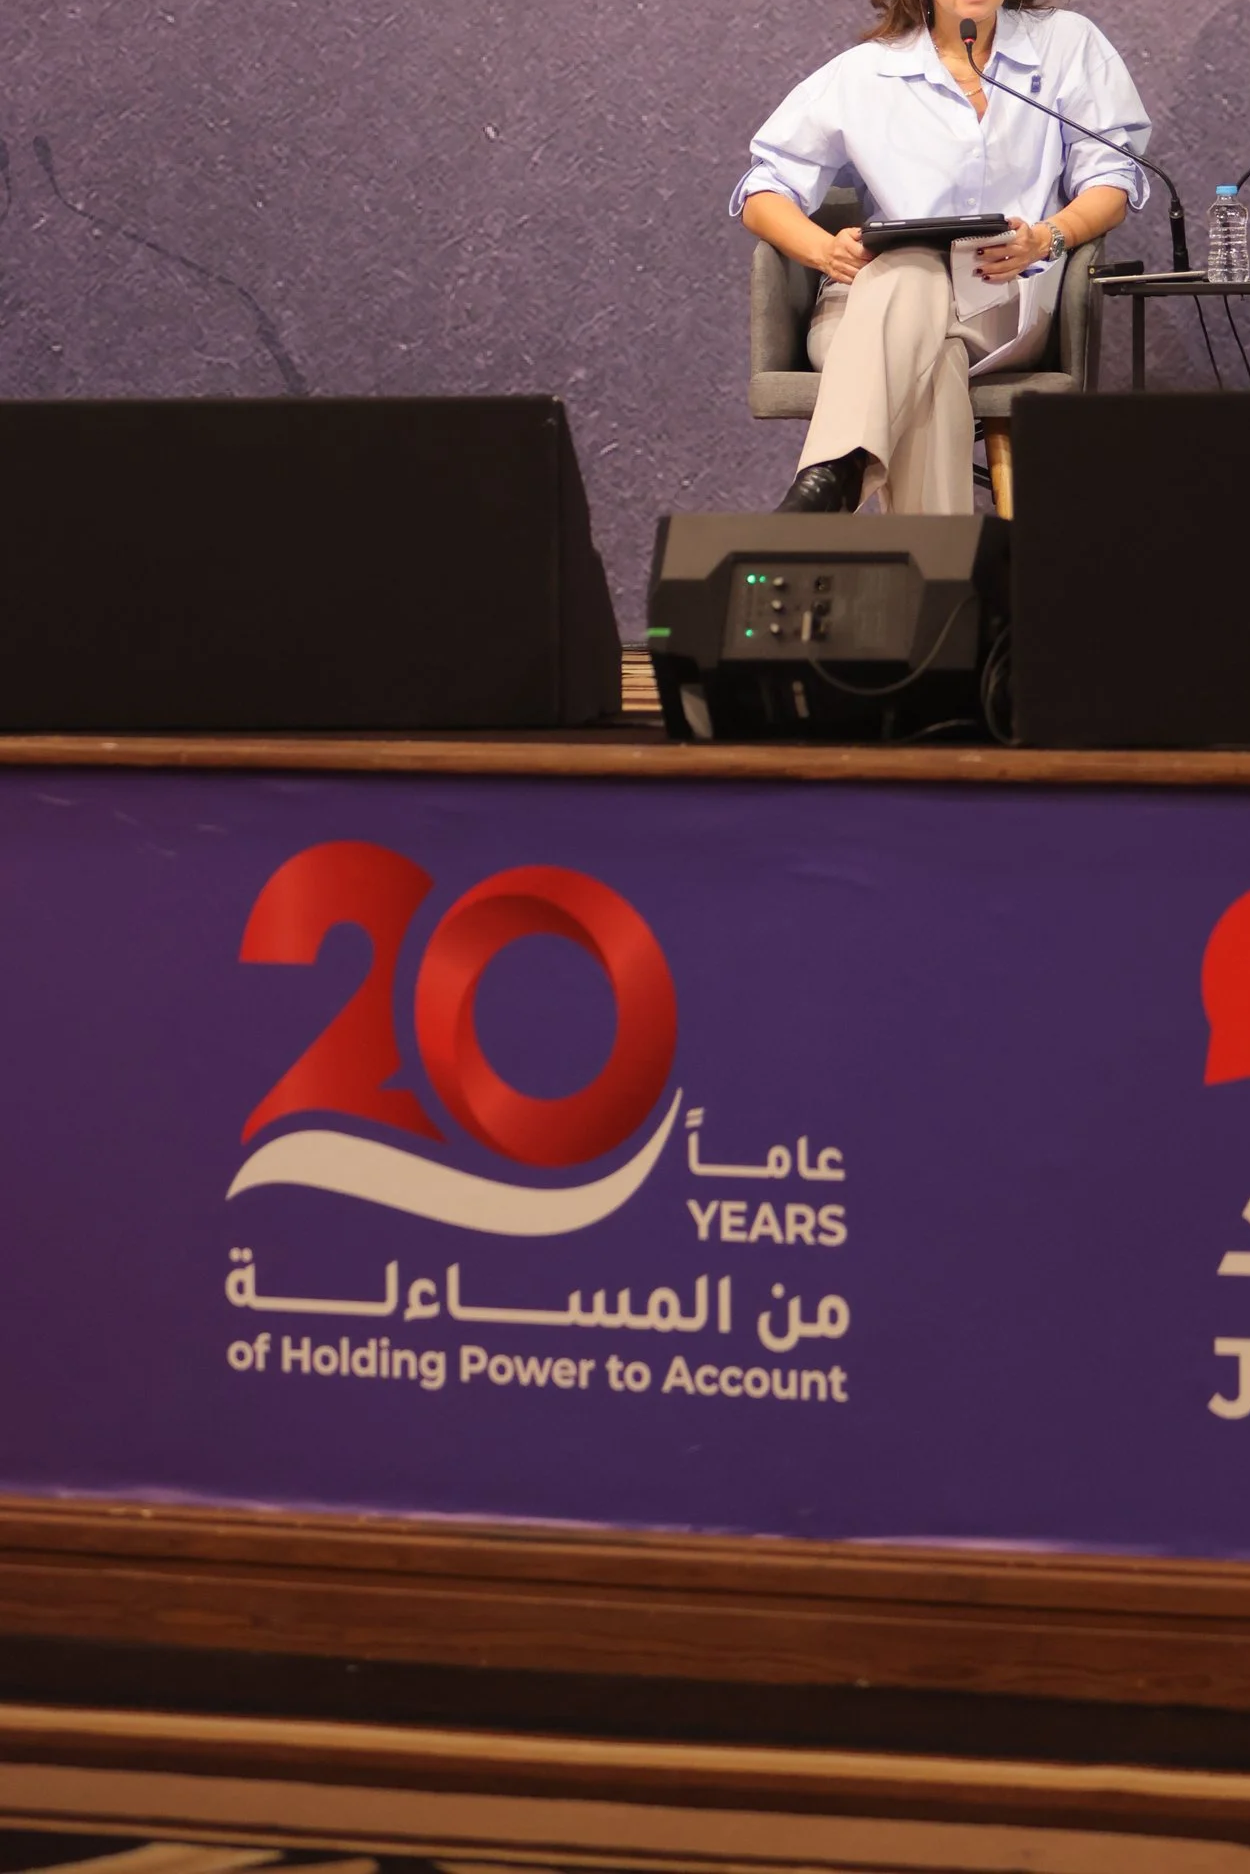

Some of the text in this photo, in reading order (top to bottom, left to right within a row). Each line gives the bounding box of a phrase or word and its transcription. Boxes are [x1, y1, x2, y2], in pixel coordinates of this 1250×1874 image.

[239, 839, 679, 1168] 20
[687, 1199, 847, 1246] YEARS
[225, 1247, 850, 1352] من المساءلة
[227, 1332, 848, 1402] of Holding Power to Account
